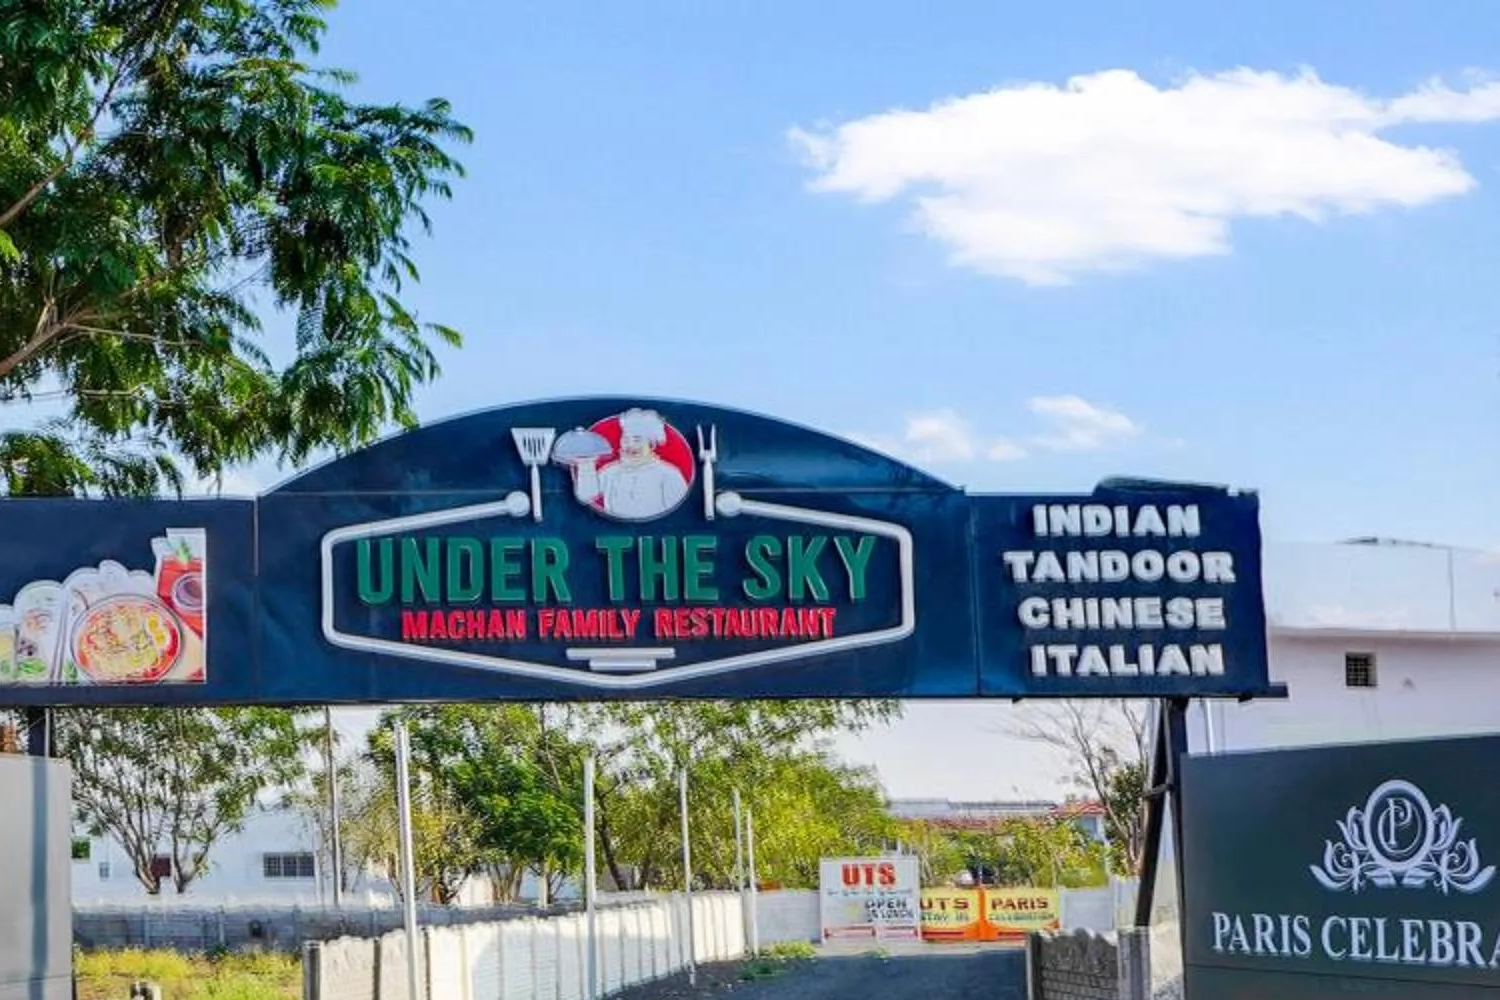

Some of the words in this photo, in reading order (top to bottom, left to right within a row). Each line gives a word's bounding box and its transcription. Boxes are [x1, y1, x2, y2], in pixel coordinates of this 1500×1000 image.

[1032, 503, 1200, 537] INDIAN
[356, 535, 570, 605] UNDER
[597, 535, 719, 602] THE
[743, 535, 876, 602] SKY
[1003, 549, 1236, 583] TANDOOR
[400, 610, 525, 641] MACHAN
[538, 609, 641, 640] FAMILY
[654, 607, 837, 639] RESTAURANT
[1017, 596, 1226, 630] CHINESE
[1030, 643, 1224, 677] ITALIAN
[842, 863, 897, 887] UTS
[920, 897, 969, 910] UTS
[991, 896, 1049, 910] PARIS
[1211, 911, 1312, 957] PARIS
